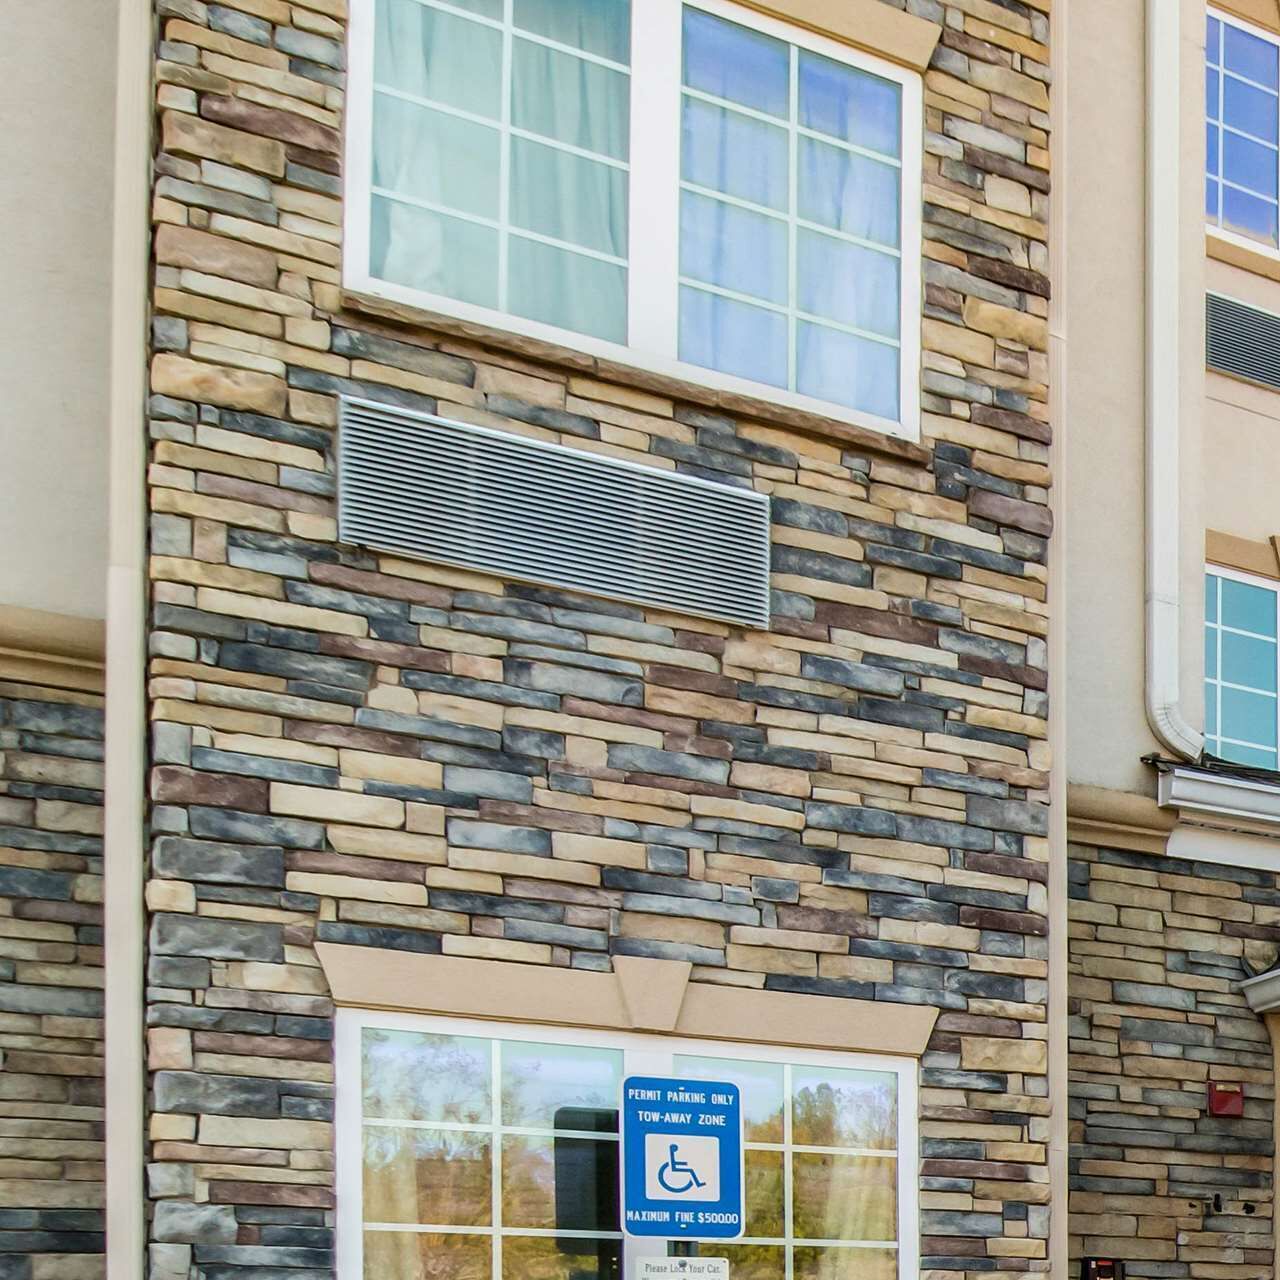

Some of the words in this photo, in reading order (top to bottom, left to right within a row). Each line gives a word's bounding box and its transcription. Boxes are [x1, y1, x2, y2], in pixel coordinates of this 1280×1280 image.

[628, 1088, 661, 1101] PERMIT
[667, 1091, 706, 1104] PARKING
[711, 1093, 734, 1105] ONLY
[638, 1110, 692, 1124] TOW-AWAY
[698, 1113, 726, 1126] ZONE
[626, 1210, 670, 1222] MAXIMUM
[675, 1212, 695, 1223] FINE
[697, 1212, 739, 1224] $500.00
[645, 1263, 668, 1273] Please
[670, 1264, 687, 1273] Lock
[689, 1264, 705, 1273] Your
